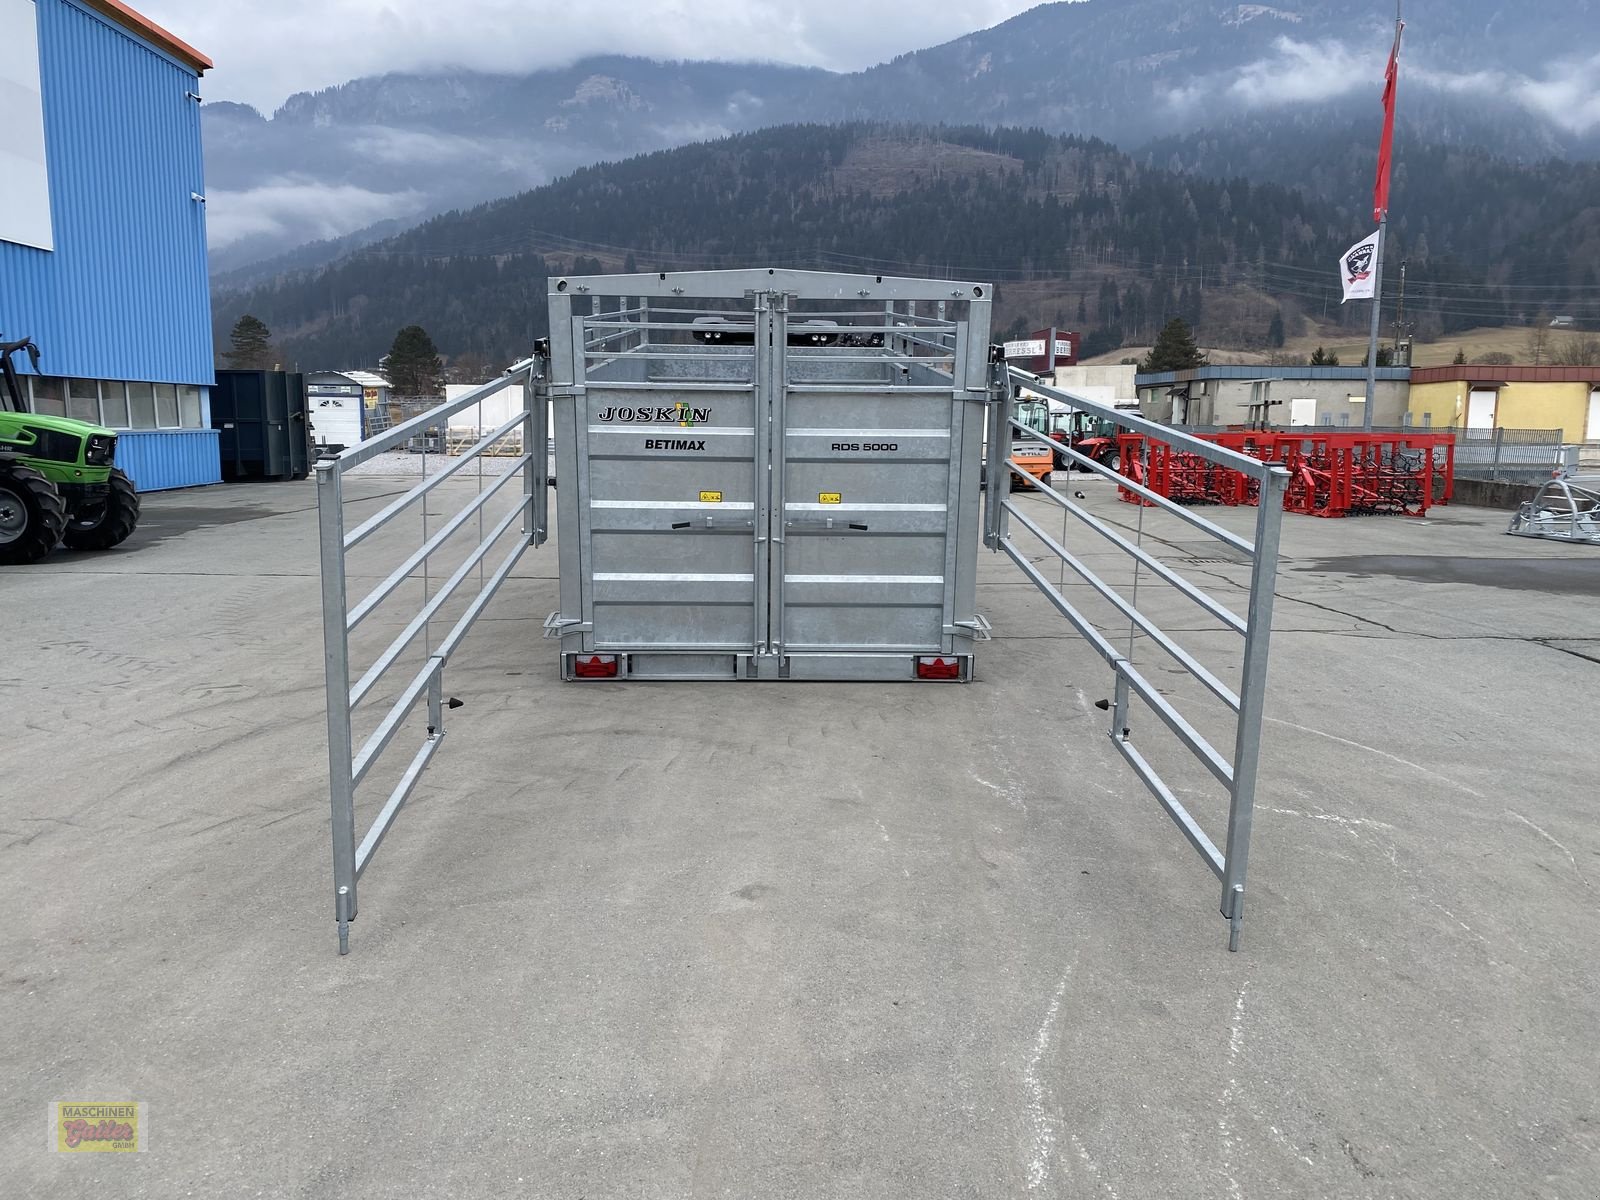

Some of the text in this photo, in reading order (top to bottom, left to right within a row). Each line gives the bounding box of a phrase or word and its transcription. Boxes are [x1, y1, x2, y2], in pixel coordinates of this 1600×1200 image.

[598, 406, 711, 422] JOSKIN
[645, 439, 705, 451] BETIMAX
[832, 443, 898, 451] RDS 5000
